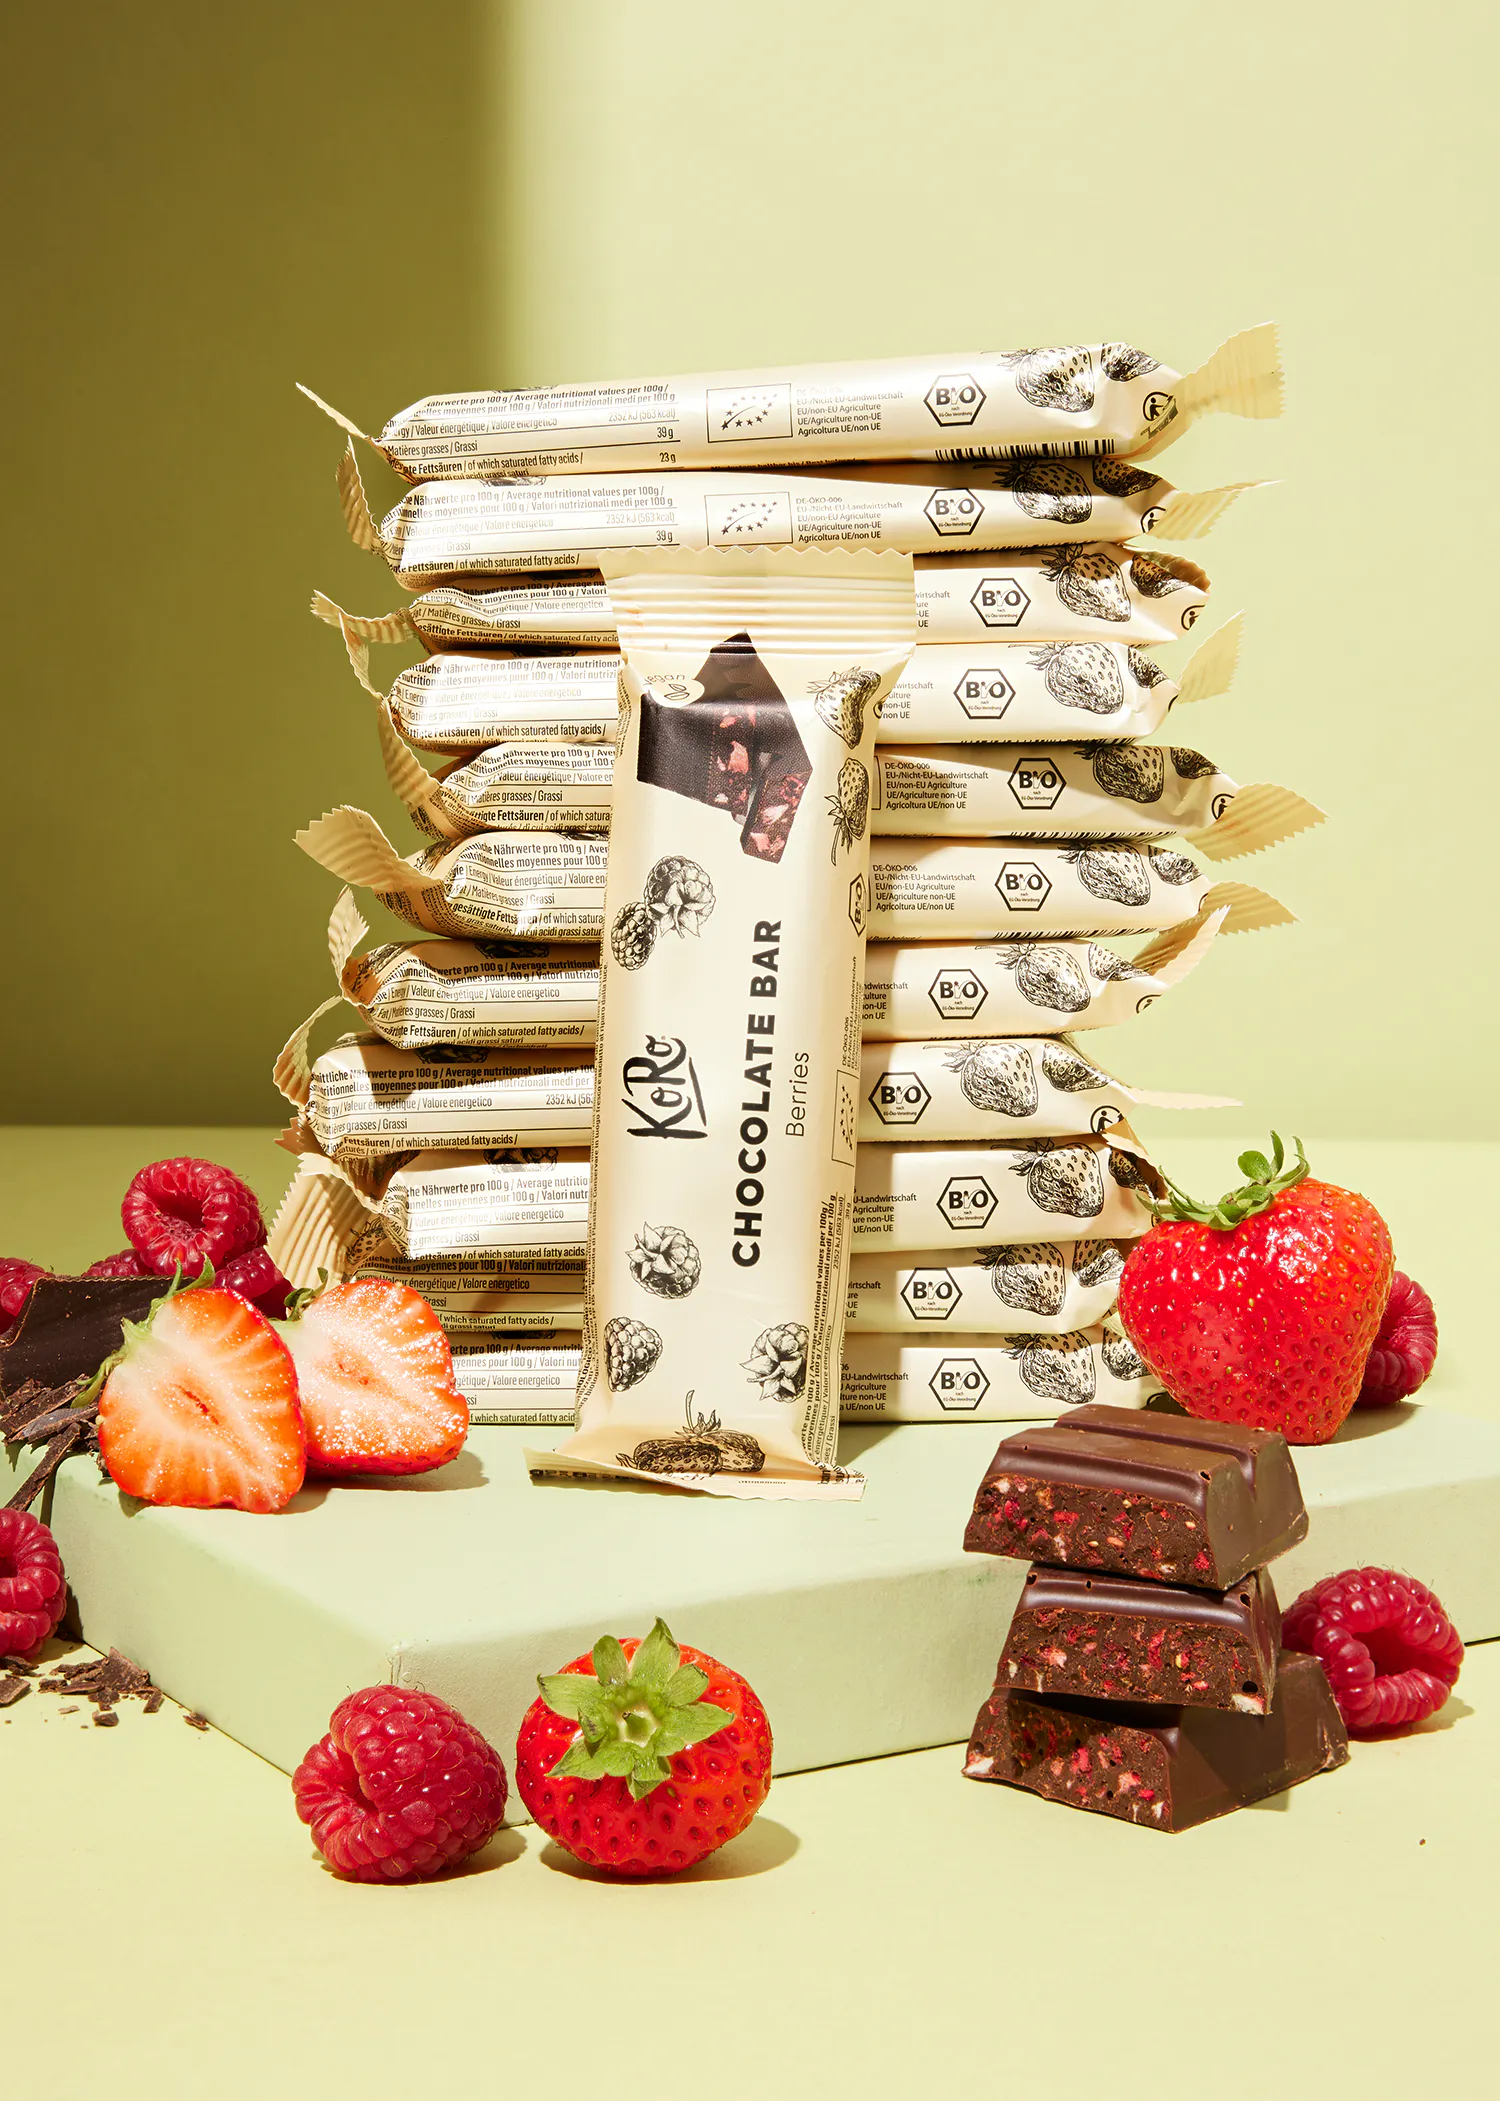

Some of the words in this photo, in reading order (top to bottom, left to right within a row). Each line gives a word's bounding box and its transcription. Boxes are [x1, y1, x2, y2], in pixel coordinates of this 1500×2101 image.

[487, 395, 503, 403] 100
[515, 391, 549, 402] Average
[551, 389, 596, 400] nutritional
[627, 387, 641, 395] per
[644, 385, 664, 393] 100g
[797, 405, 838, 416] EU/non-EU
[840, 404, 881, 414] Agriculture
[798, 415, 852, 426] UE/Agriculture
[854, 412, 881, 421] non-UE
[656, 427, 666, 438] 39
[798, 427, 839, 437] Agricoltura
[421, 445, 448, 457] grasses
[454, 440, 477, 451] Grassi
[419, 462, 461, 474] Fettsäuren
[468, 461, 476, 471] of
[477, 459, 499, 469] which
[501, 455, 537, 468] saturated
[539, 455, 556, 466] fatty
[559, 453, 579, 464] acids
[660, 453, 667, 462] 23
[798, 514, 838, 522] EU/non-EU
[840, 513, 881, 521] Agriculture
[798, 524, 852, 533] UE/Agriculture
[854, 521, 882, 529] non-UE
[656, 530, 666, 541] 39
[798, 534, 839, 543] Agricoltura
[841, 532, 869, 540] UE/non
[460, 561, 468, 569] of
[469, 559, 492, 568] which
[495, 555, 532, 568] saturated
[534, 555, 552, 566] fatty
[554, 554, 575, 565] acids
[434, 726, 481, 738] Fettsäuren
[486, 726, 494, 736] of
[496, 725, 519, 737] which
[521, 725, 558, 737] saturated
[560, 725, 580, 737] fatty
[581, 725, 601, 735] acids
[885, 761, 930, 770] DE-ÖKO-006
[886, 771, 988, 779] EU-/Nicht-EU-Landwirtschaft
[927, 781, 967, 790] Agriculture
[502, 791, 533, 802] grasses
[538, 790, 562, 801] Grassi
[941, 791, 966, 799] non-UE
[886, 802, 926, 810] Agricoltura
[927, 801, 954, 809] UE/non
[498, 811, 544, 821] Fettsäuren
[550, 811, 559, 820] of
[561, 810, 585, 820] which
[494, 843, 540, 855] Nährwerte
[543, 845, 557, 854] pro
[558, 843, 574, 853] 100
[517, 857, 561, 869] moyennes
[564, 857, 584, 867] pour
[585, 855, 601, 865] 100
[873, 863, 917, 871] DE-ÖKO-006
[874, 873, 975, 881] EU-/Nicht-EU-Landwirtschaft
[915, 883, 955, 892] Agriculture
[876, 893, 929, 901] UE/Agriculture
[876, 903, 915, 911] Agricoltura
[945, 902, 954, 910] UE
[750, 920, 781, 998] BAR
[414, 1006, 444, 1019] grasses
[450, 1007, 475, 1018] Grassi
[410, 1025, 456, 1038] Fettsäuren
[462, 1026, 471, 1037] of
[472, 1026, 496, 1037] which
[498, 1025, 536, 1036] saturated
[537, 1024, 557, 1036] fatty
[557, 1024, 580, 1035] acids
[399, 1069, 414, 1079] pro
[416, 1068, 431, 1078] 100
[446, 1066, 482, 1078] Average
[483, 1065, 530, 1076] nutritional
[531, 1065, 562, 1074] values
[785, 1052, 810, 1137] Berries
[347, 1119, 376, 1133] grasses
[382, 1118, 408, 1130] Grassi
[344, 1136, 389, 1147] Fettsäuren
[396, 1135, 406, 1147] of
[407, 1135, 430, 1147] which
[431, 1135, 470, 1147] saturated
[471, 1135, 491, 1146] fatty
[491, 1135, 514, 1144] acids
[731, 1014, 775, 1268] CHOCOLATE
[853, 1204, 894, 1214] Agriculture
[819, 1207, 827, 1228] 100g
[866, 1214, 894, 1223] non-UE
[854, 1224, 881, 1233] UE/non
[883, 1223, 893, 1232] UE
[469, 1249, 477, 1260] of
[478, 1249, 501, 1260] which
[503, 1248, 541, 1259] saturated
[544, 1247, 563, 1259] fatty
[563, 1247, 584, 1257] acids
[817, 1249, 825, 1282] values
[462, 1277, 487, 1290] Valore
[489, 1277, 530, 1290] energetico
[813, 1287, 823, 1330] nutritional
[443, 1316, 467, 1325] which
[469, 1316, 505, 1325] saturated
[507, 1315, 526, 1326] fatty
[526, 1316, 549, 1325] acids
[809, 1334, 819, 1370] Average
[492, 1375, 517, 1386] Valore
[519, 1374, 560, 1386] energetico
[845, 1382, 886, 1392] Agriculture
[858, 1392, 886, 1401] non-UE
[845, 1402, 873, 1410] UE/non
[875, 1401, 885, 1410] UE
